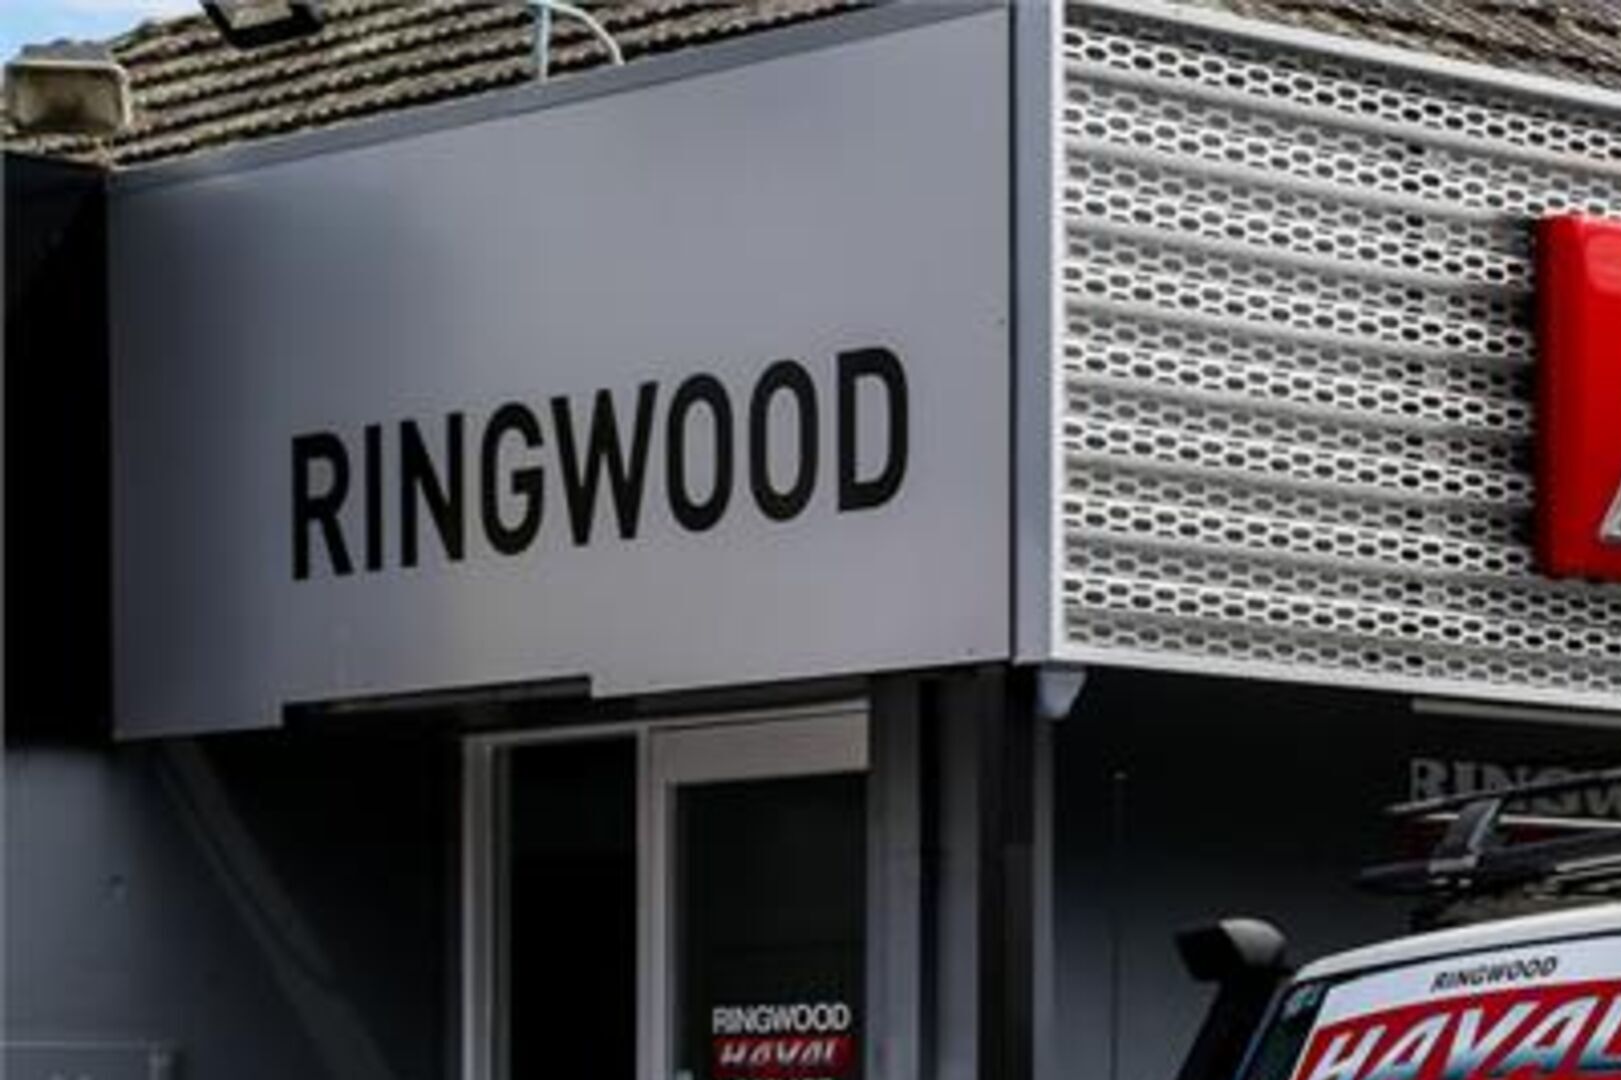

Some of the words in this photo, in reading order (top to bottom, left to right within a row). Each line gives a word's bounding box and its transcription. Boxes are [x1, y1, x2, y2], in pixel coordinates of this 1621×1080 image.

[292, 346, 909, 581] RINGWOOD
[1430, 956, 1559, 993] RINGWOOD
[712, 1003, 851, 1034] RINGWOOD
[719, 1040, 838, 1066] HAVAL
